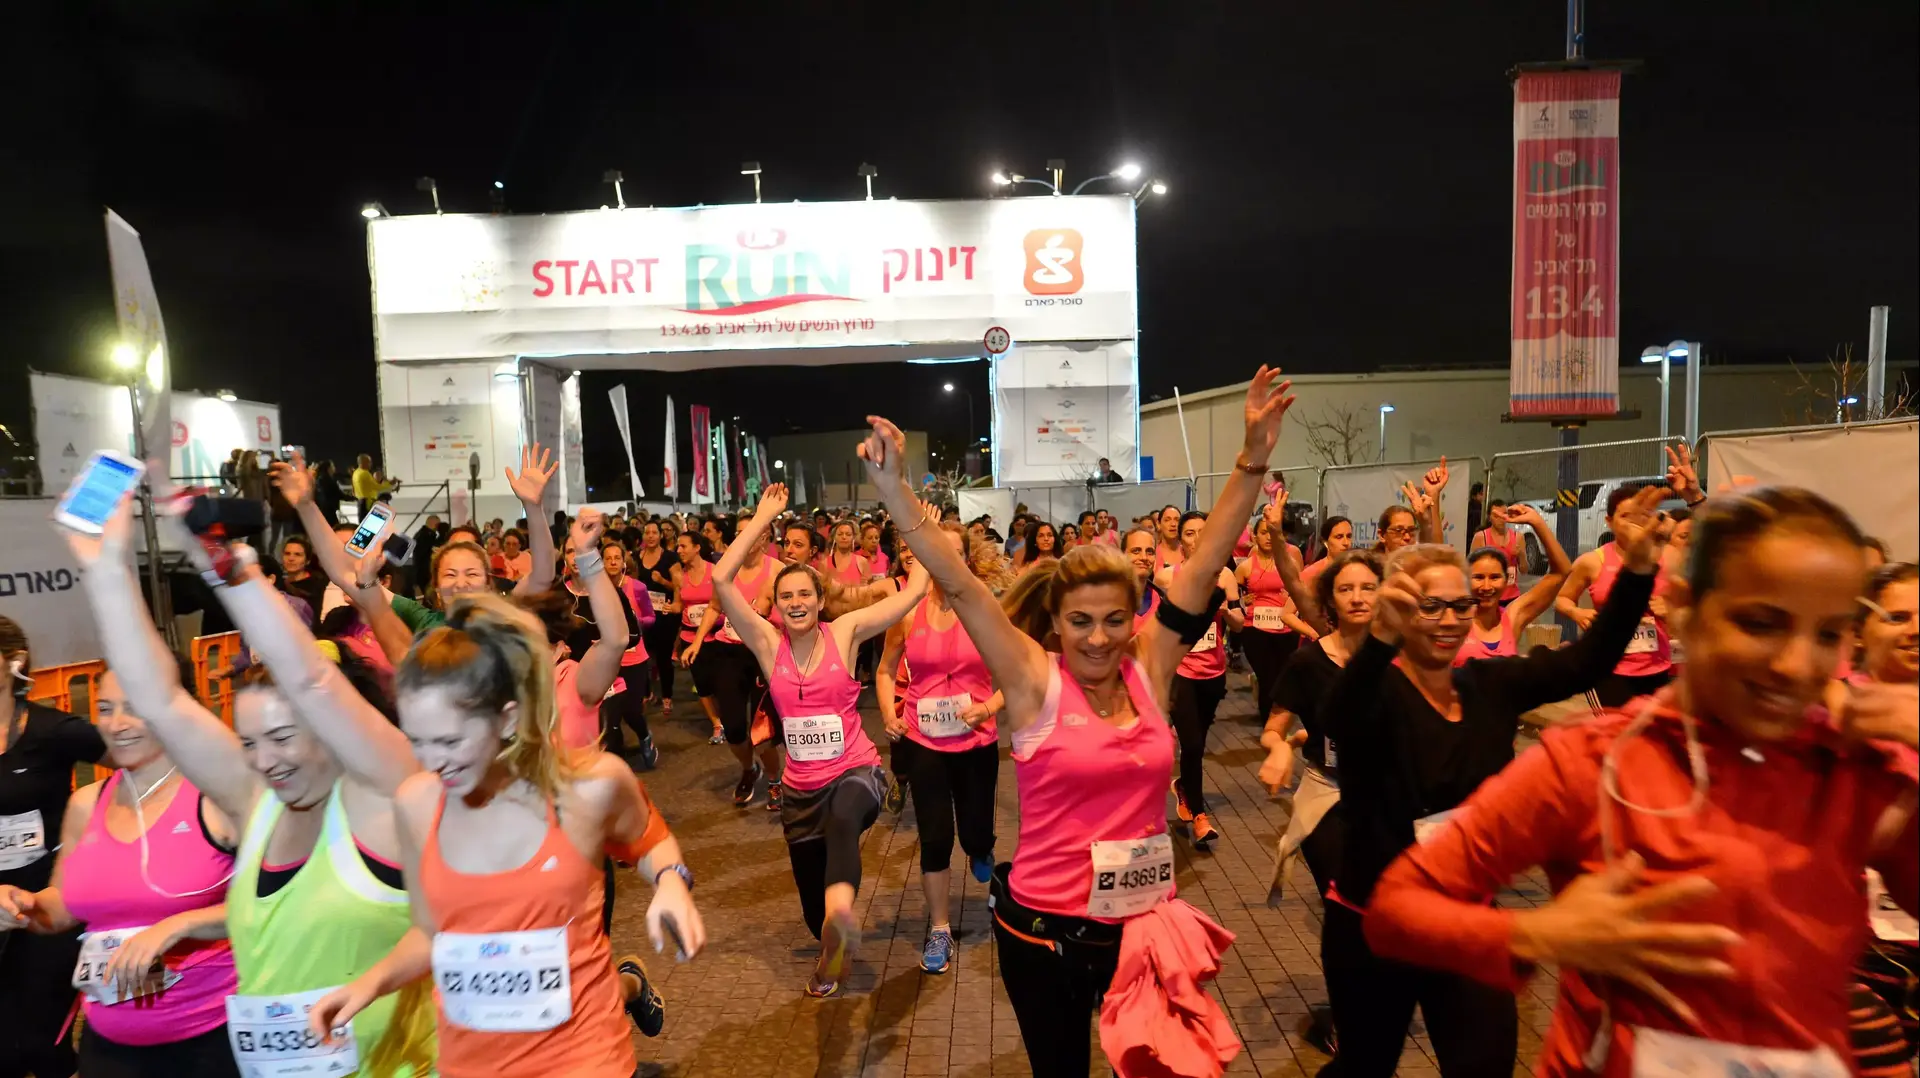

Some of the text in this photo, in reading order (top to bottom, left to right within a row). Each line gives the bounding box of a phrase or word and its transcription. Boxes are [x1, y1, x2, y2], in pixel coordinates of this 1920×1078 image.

[1530, 158, 1605, 193] RUN
[1526, 203, 1607, 222] מרוץ הנשים
[1555, 230, 1577, 248] של
[532, 244, 847, 310] START RUN
[881, 245, 977, 293] זינוק
[1025, 297, 1083, 306] סופר-פארם
[1526, 284, 1604, 320] 13.4
[660, 322, 711, 337] 13.4.16
[775, 316, 795, 333] של
[800, 317, 840, 333] הנשים
[843, 317, 875, 335] מרוץ
[0, 568, 80, 597] -פארם
[798, 732, 827, 745] 3031
[1118, 866, 1157, 889] 4369
[261, 1027, 320, 1052] 4338
